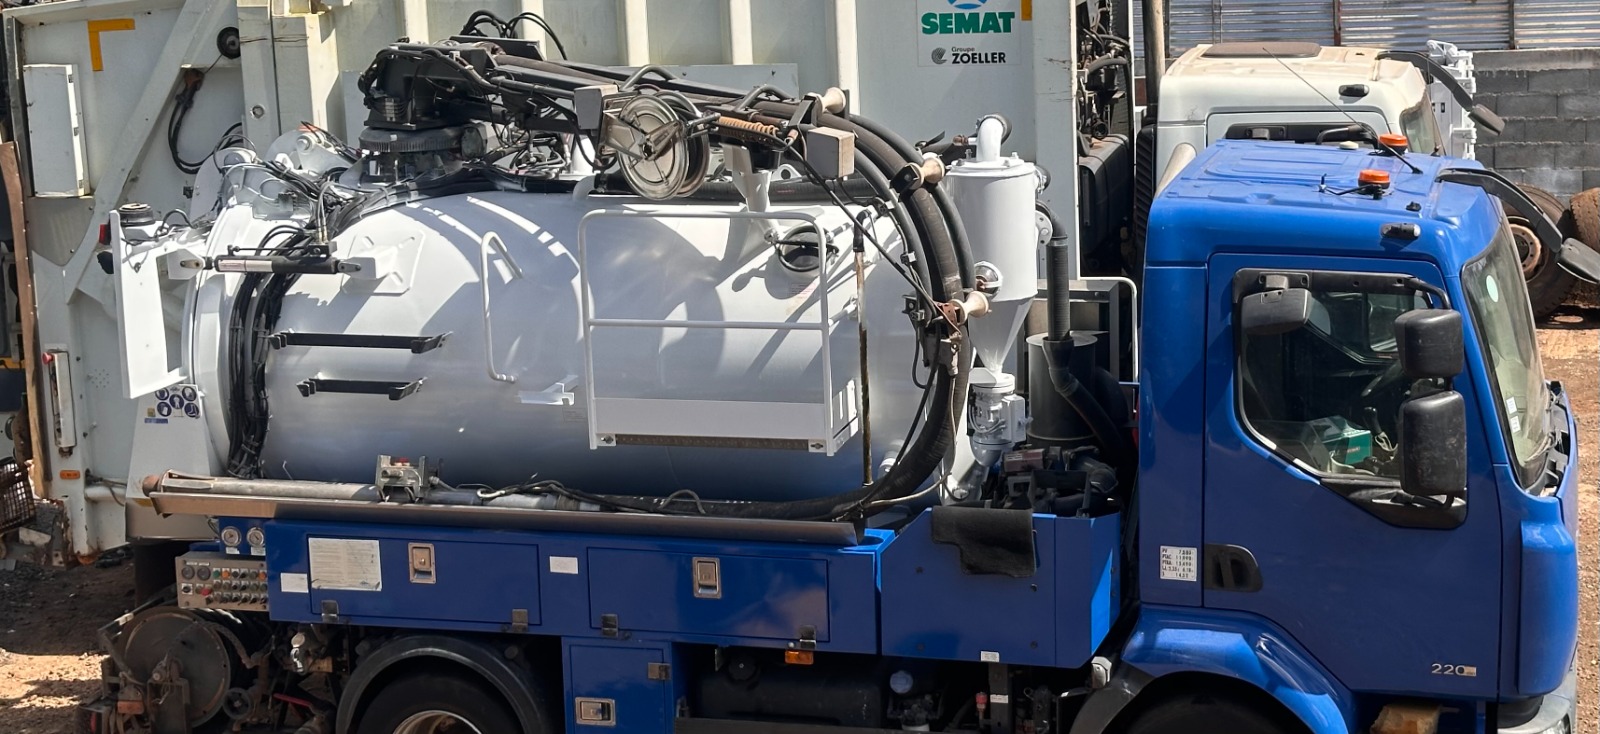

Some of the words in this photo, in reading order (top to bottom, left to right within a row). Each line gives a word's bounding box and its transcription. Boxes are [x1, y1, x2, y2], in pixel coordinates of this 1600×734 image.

[921, 12, 1015, 34] SEMAT
[952, 52, 1006, 65] ZOELLER
[1431, 663, 1466, 676] 220
